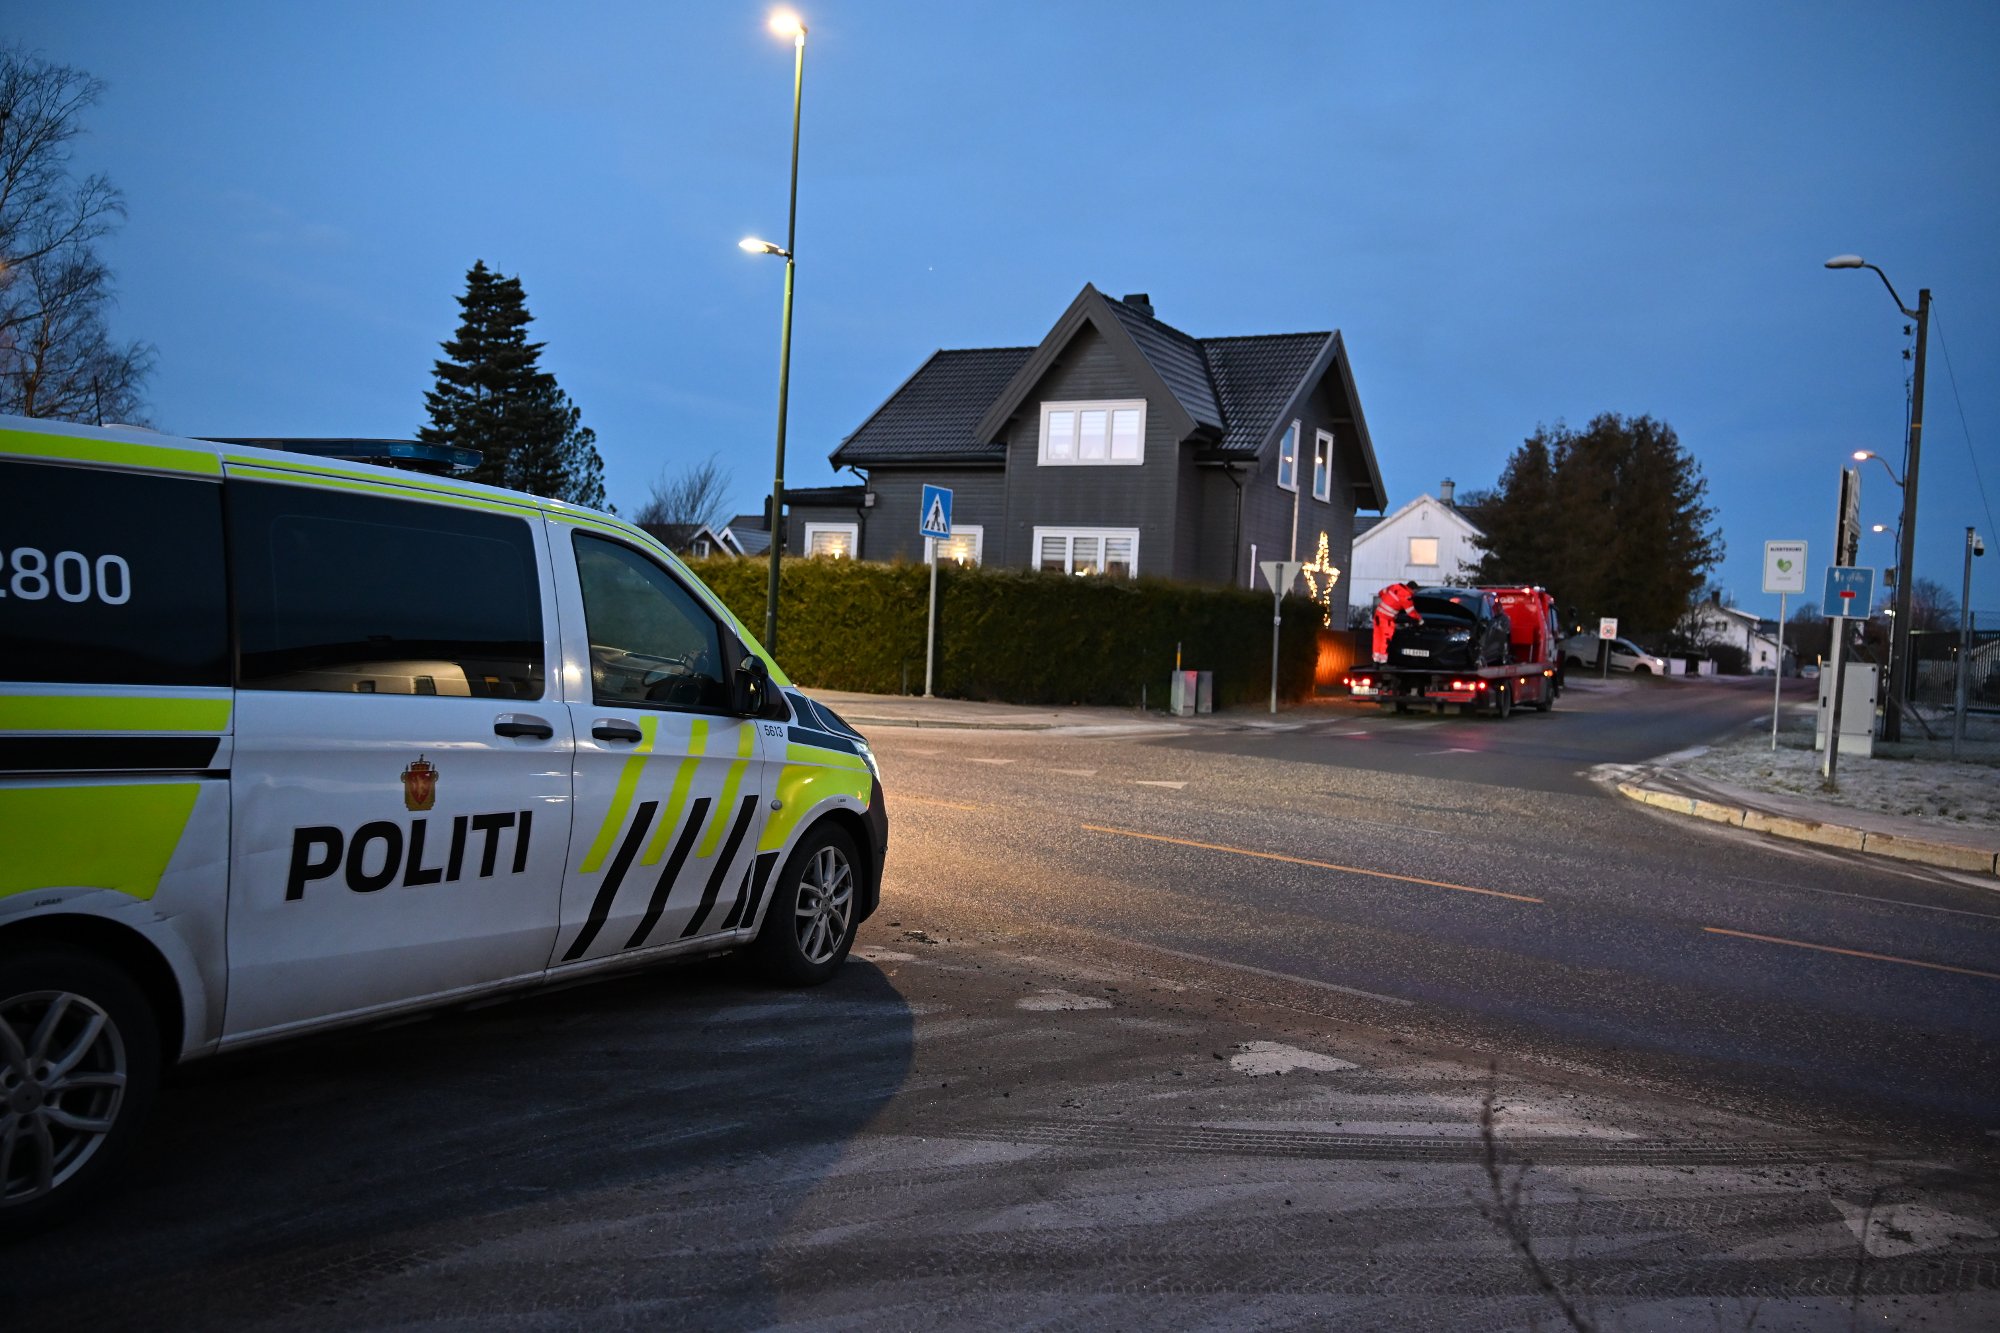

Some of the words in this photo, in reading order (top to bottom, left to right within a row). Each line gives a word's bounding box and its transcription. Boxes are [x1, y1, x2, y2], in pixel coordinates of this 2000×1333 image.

[0, 547, 131, 605] 800
[764, 725, 783, 737] 5613
[285, 810, 533, 901] POLITI
